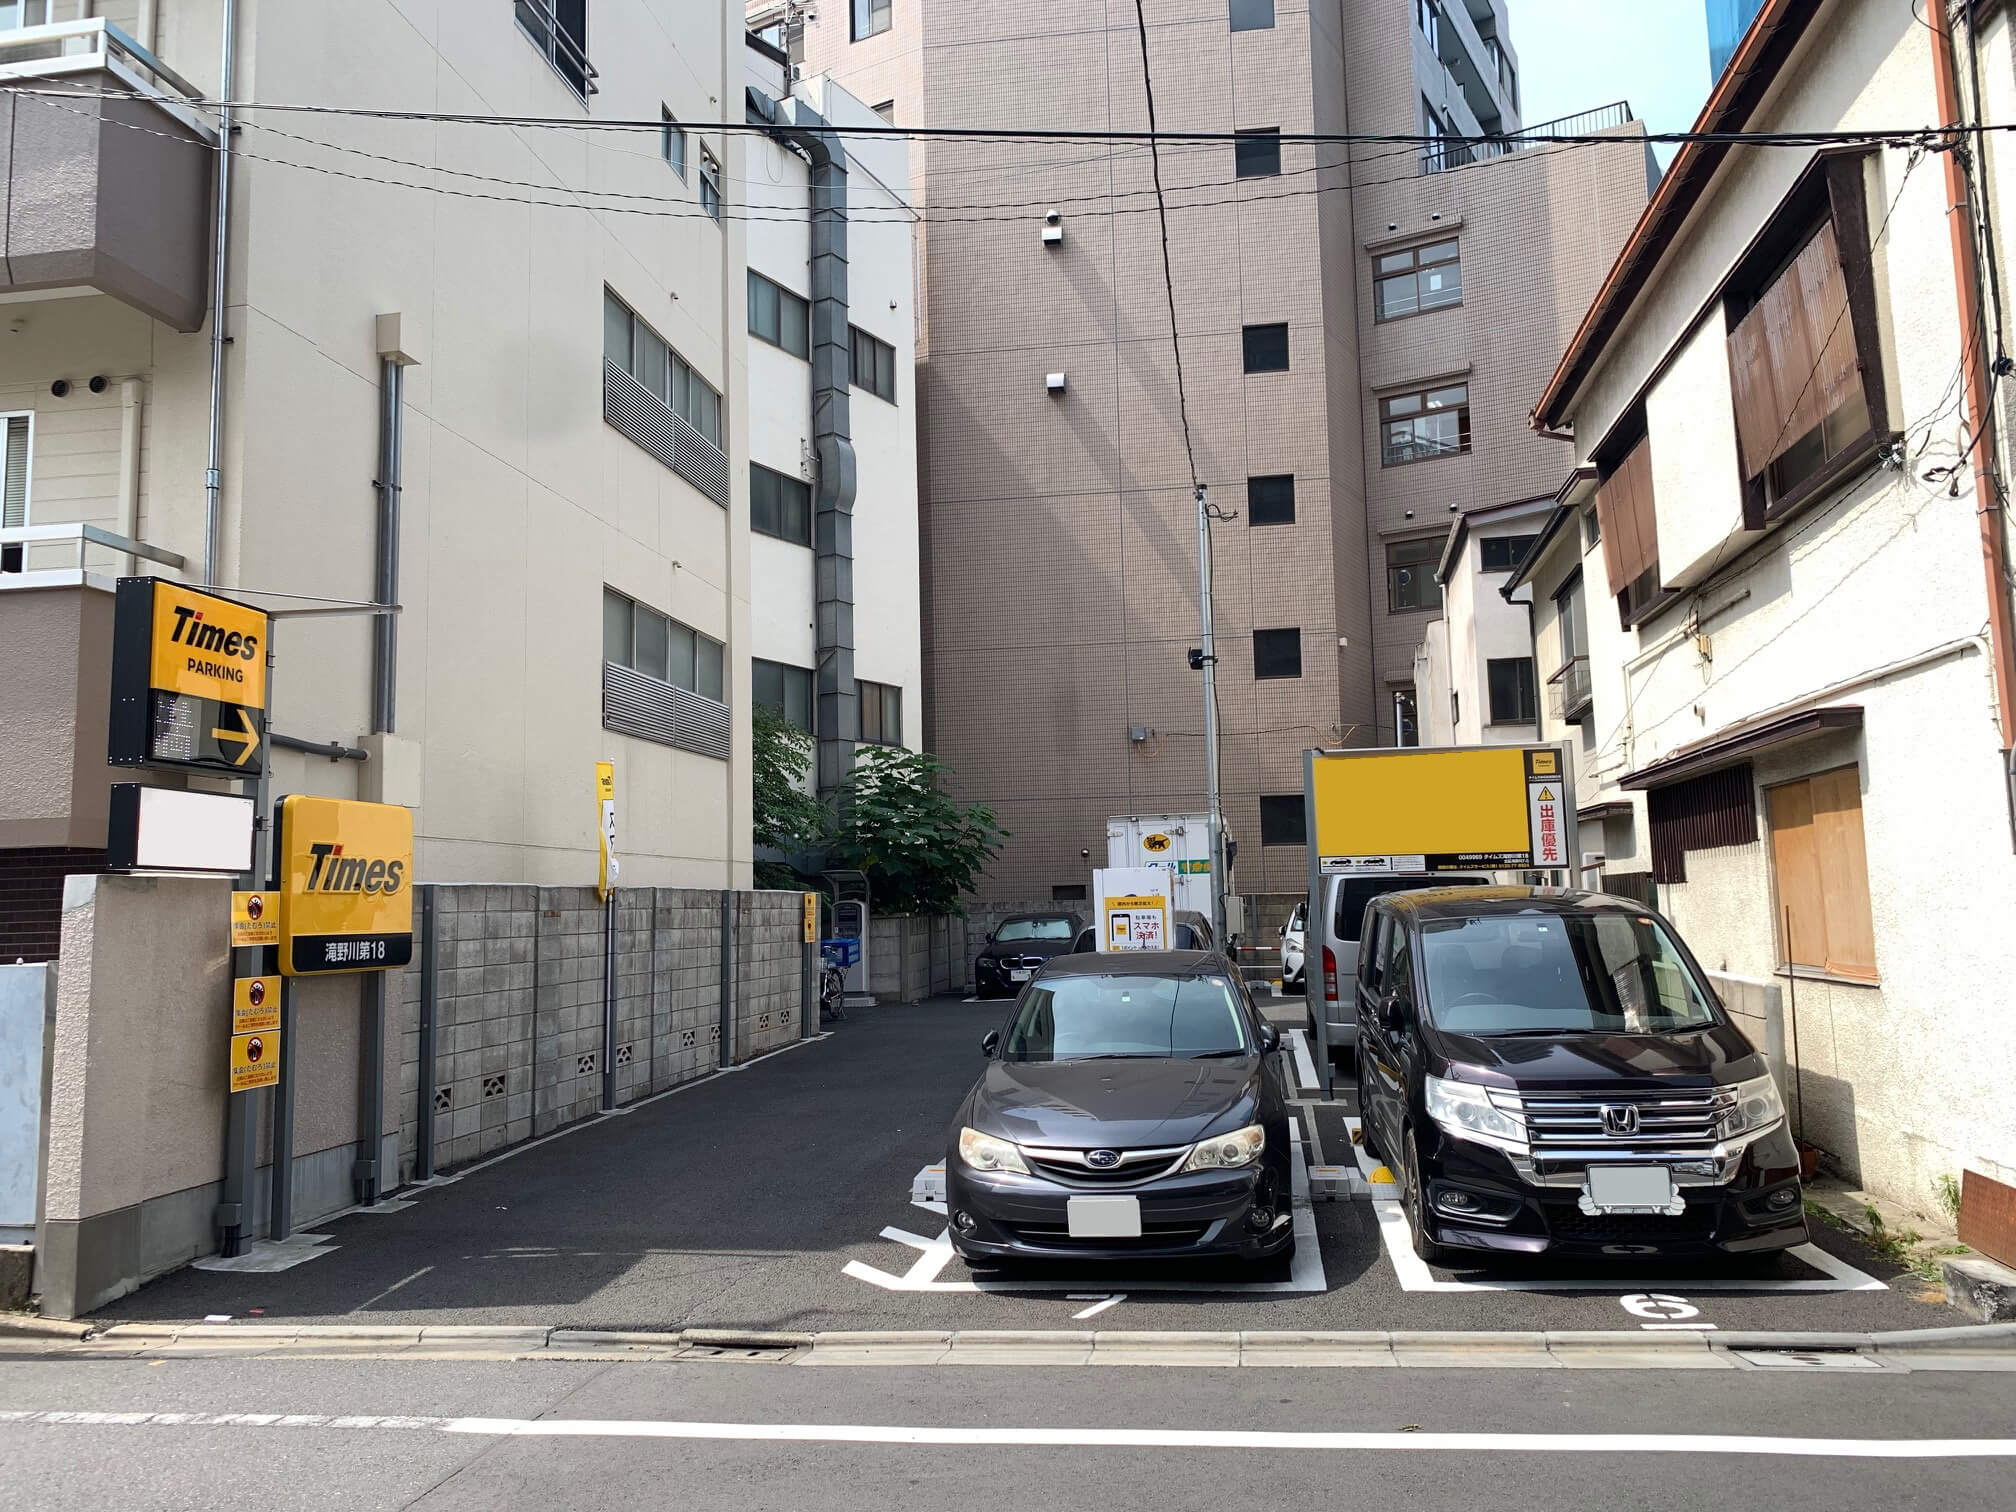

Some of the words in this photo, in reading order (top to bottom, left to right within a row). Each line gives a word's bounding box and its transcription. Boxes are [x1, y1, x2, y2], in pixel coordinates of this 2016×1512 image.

[170, 605, 258, 661] Times
[187, 657, 244, 683] PARKING
[1540, 804, 1558, 862] 出庫優先
[307, 843, 404, 893] Times
[1134, 922, 1160, 930] スマホ
[1136, 930, 1158, 940] 決済!
[325, 941, 386, 963] 滝野川第18
[1619, 1293, 1700, 1319] 6
